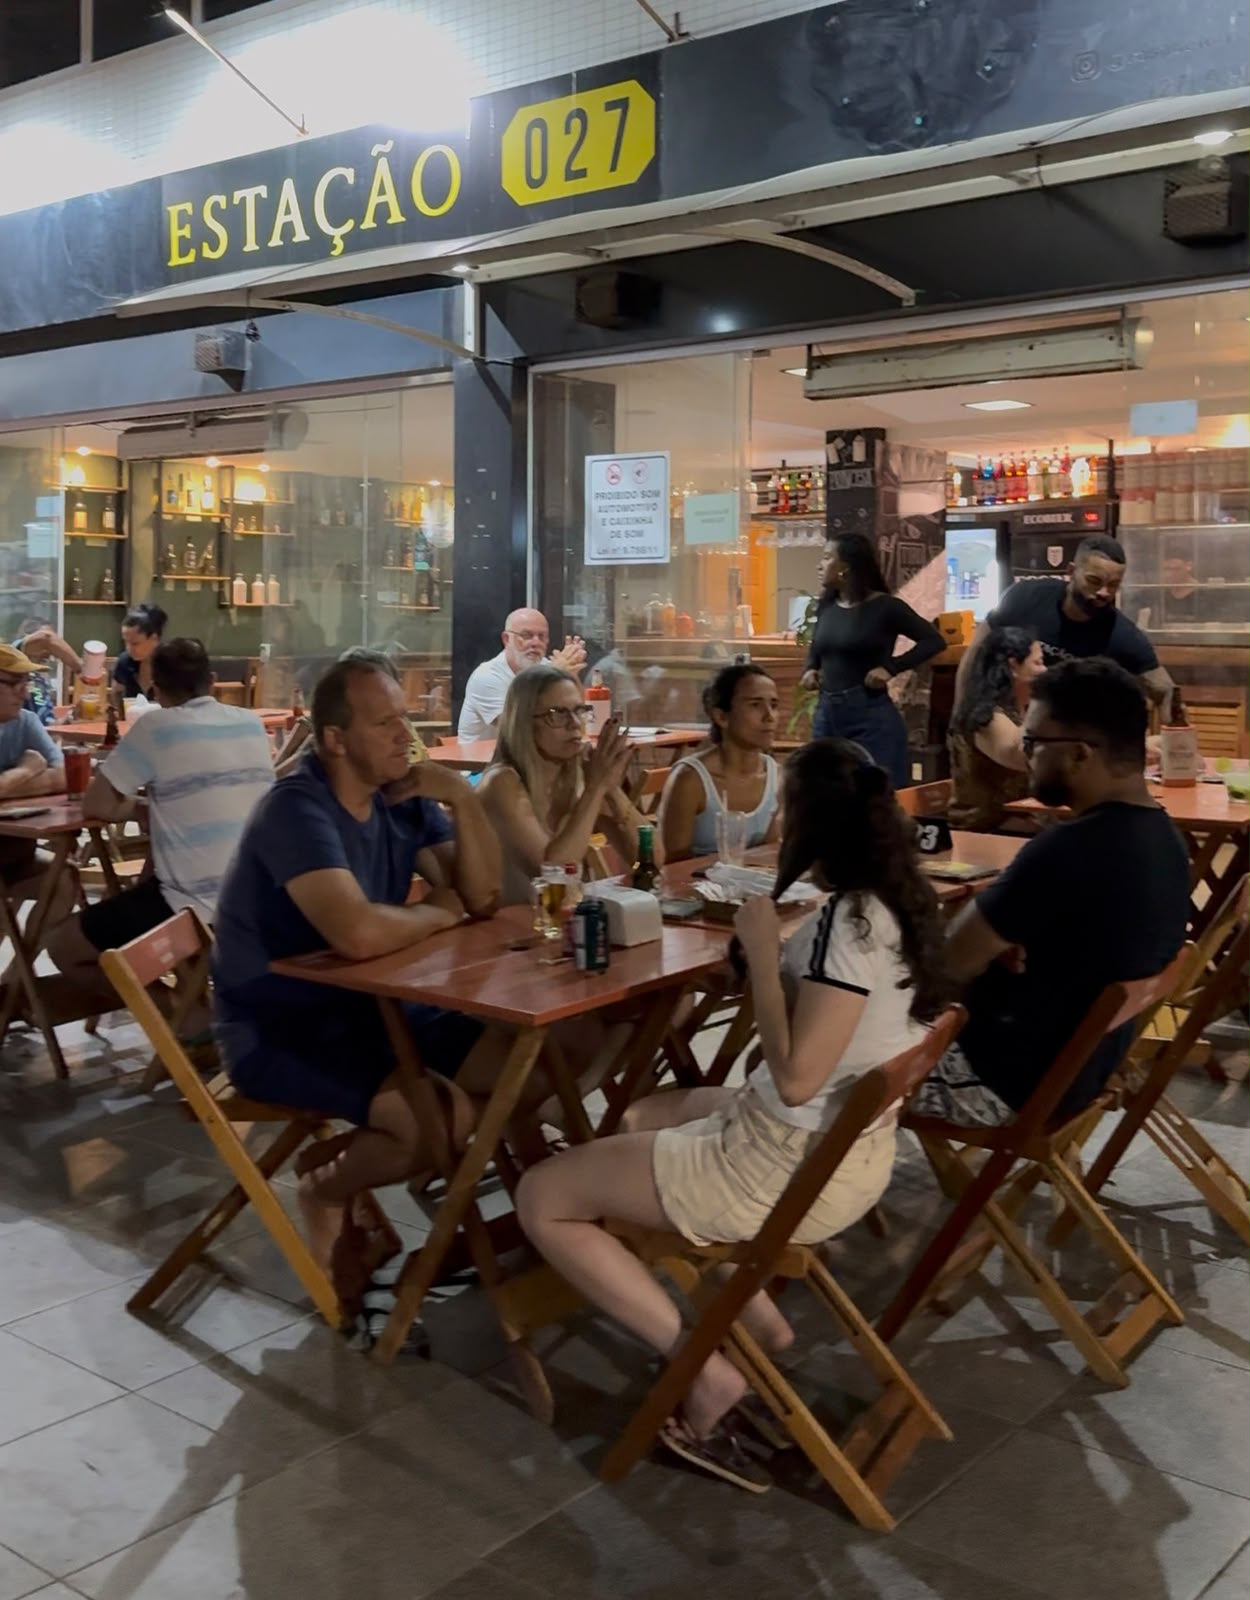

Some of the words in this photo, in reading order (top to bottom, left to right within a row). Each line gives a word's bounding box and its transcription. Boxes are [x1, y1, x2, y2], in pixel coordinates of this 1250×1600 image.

[167, 139, 462, 267] ESTAÇÃO
[524, 97, 630, 190] 027
[595, 490, 638, 500] PROIBIDO
[641, 488, 661, 499] SOM
[598, 502, 658, 513] AUTOMOTIVO
[601, 518, 607, 527] E
[610, 529, 622, 539] DE
[624, 528, 644, 539] SOM
